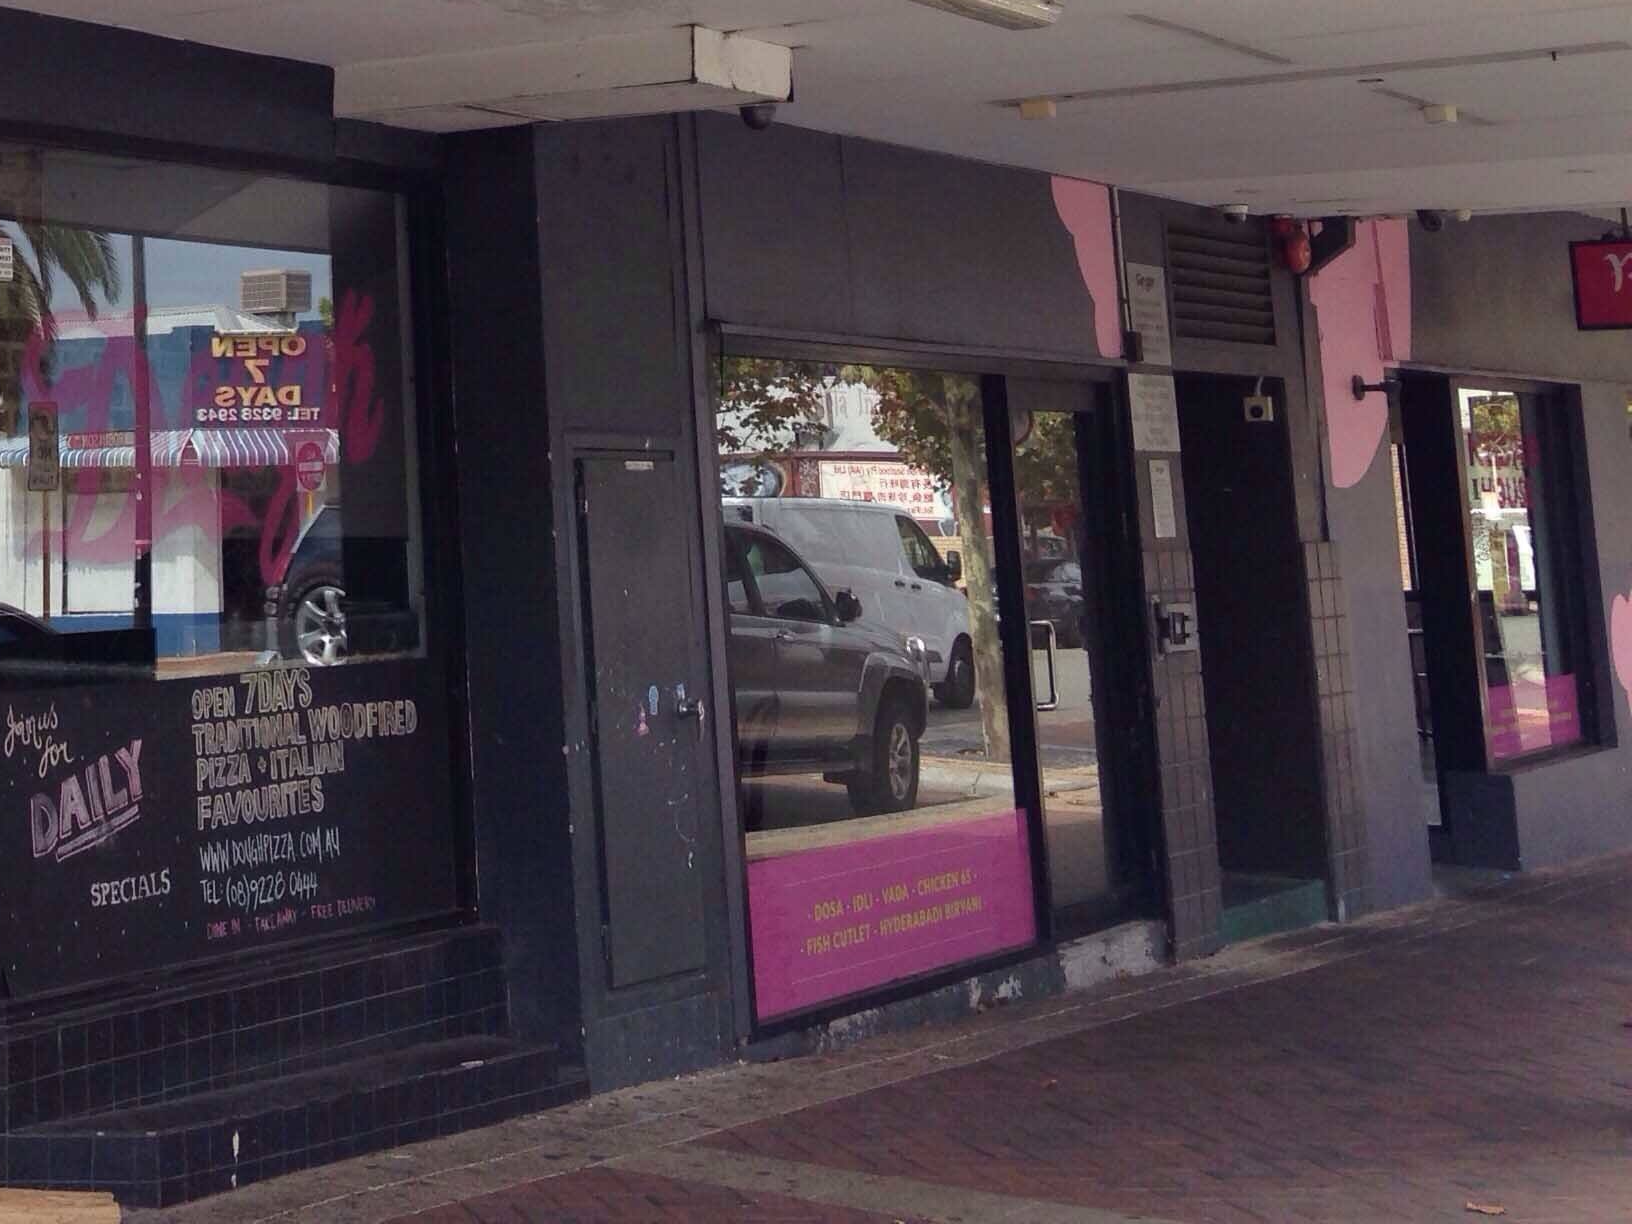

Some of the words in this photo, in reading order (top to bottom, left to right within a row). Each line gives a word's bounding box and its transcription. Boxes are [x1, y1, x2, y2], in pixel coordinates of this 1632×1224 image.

[192, 686, 235, 720] OPEN
[192, 712, 307, 756] TRADITIONAL
[308, 699, 418, 742] WOODFIRED
[39, 735, 74, 778] for
[196, 753, 252, 791] PIZZA
[270, 740, 345, 780] ITALIAN
[31, 739, 143, 858] DAILY
[196, 776, 325, 831] FAVOURITES
[91, 867, 171, 907] SPECIALS
[200, 880, 224, 904] TEL:
